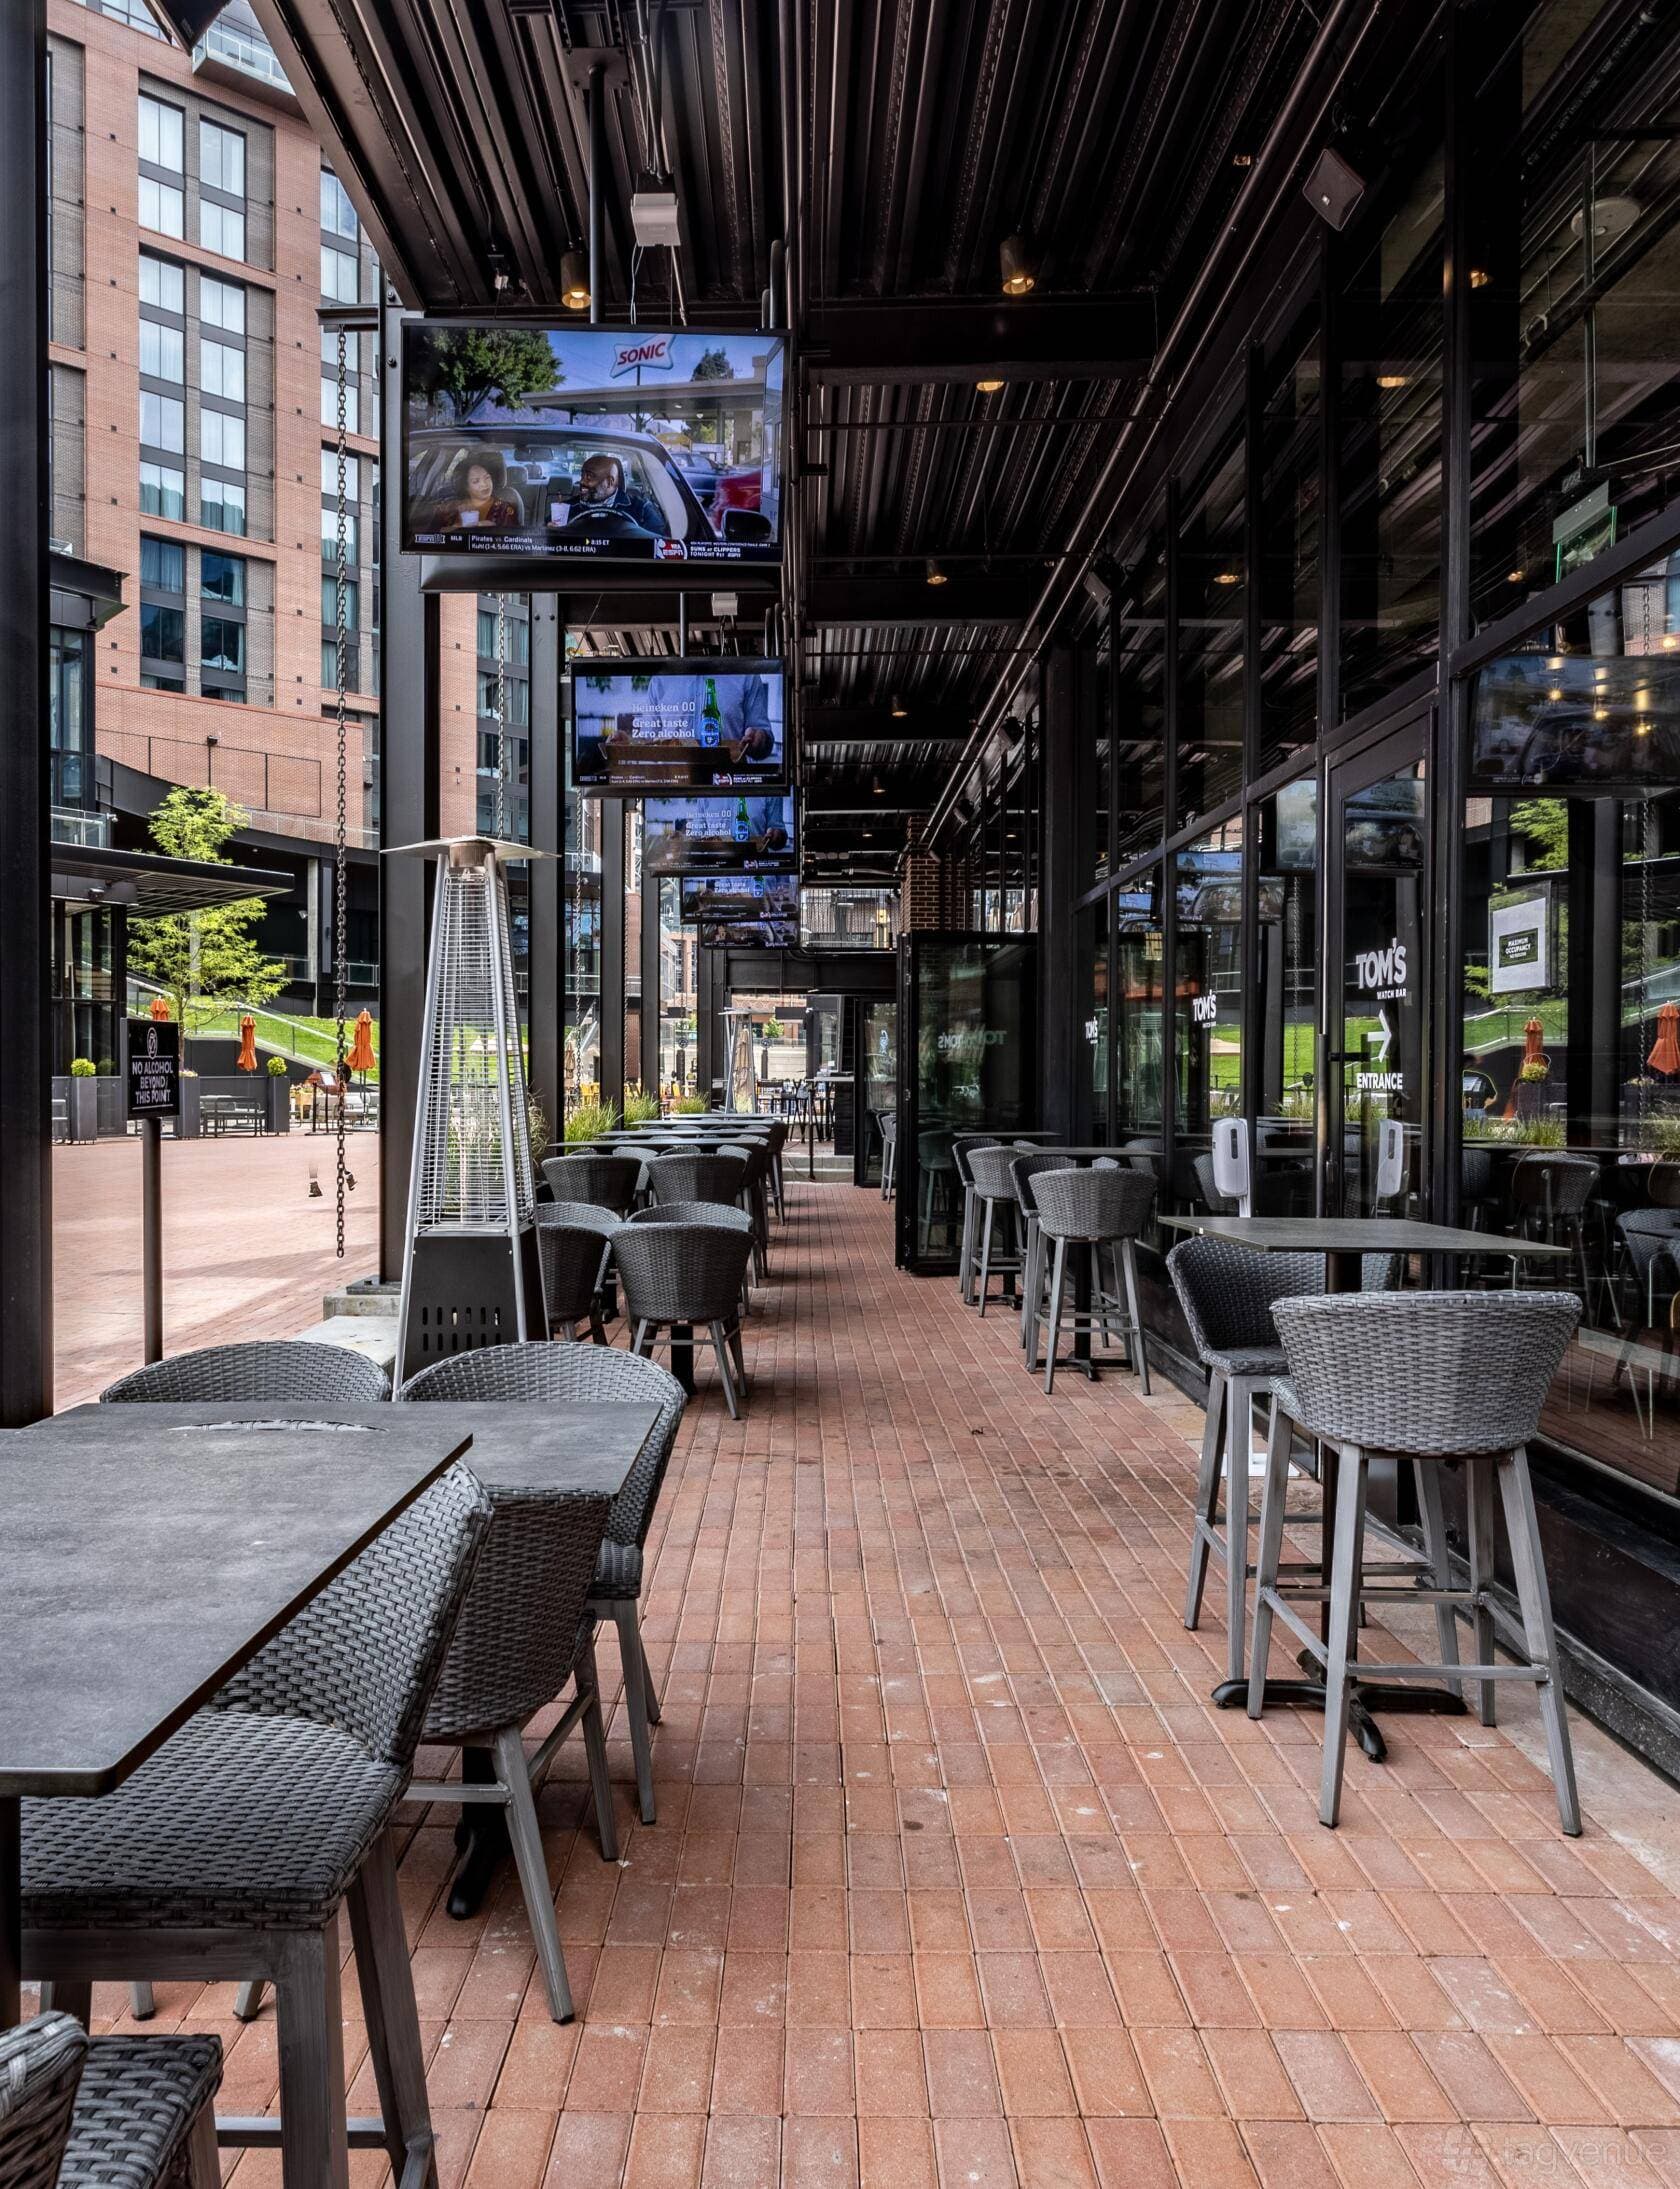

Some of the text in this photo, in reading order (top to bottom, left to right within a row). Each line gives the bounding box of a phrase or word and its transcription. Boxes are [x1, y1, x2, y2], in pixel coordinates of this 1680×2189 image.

[617, 342, 666, 365] SONIC
[632, 703, 679, 712] Heineken
[632, 718, 689, 728] Great taste
[632, 729, 695, 738] Zero alcohol
[1505, 943, 1531, 955] OCCUPANCY
[1355, 937, 1407, 989] TOM'S
[1396, 988, 1407, 998] BAR
[1192, 988, 1217, 1022] TOM'S
[132, 1061, 173, 1075] NO ALCOHOL
[140, 1075, 166, 1089] BEYOND
[1356, 1072, 1404, 1090] ENTRANCE
[135, 1089, 171, 1104] THIS POINT
